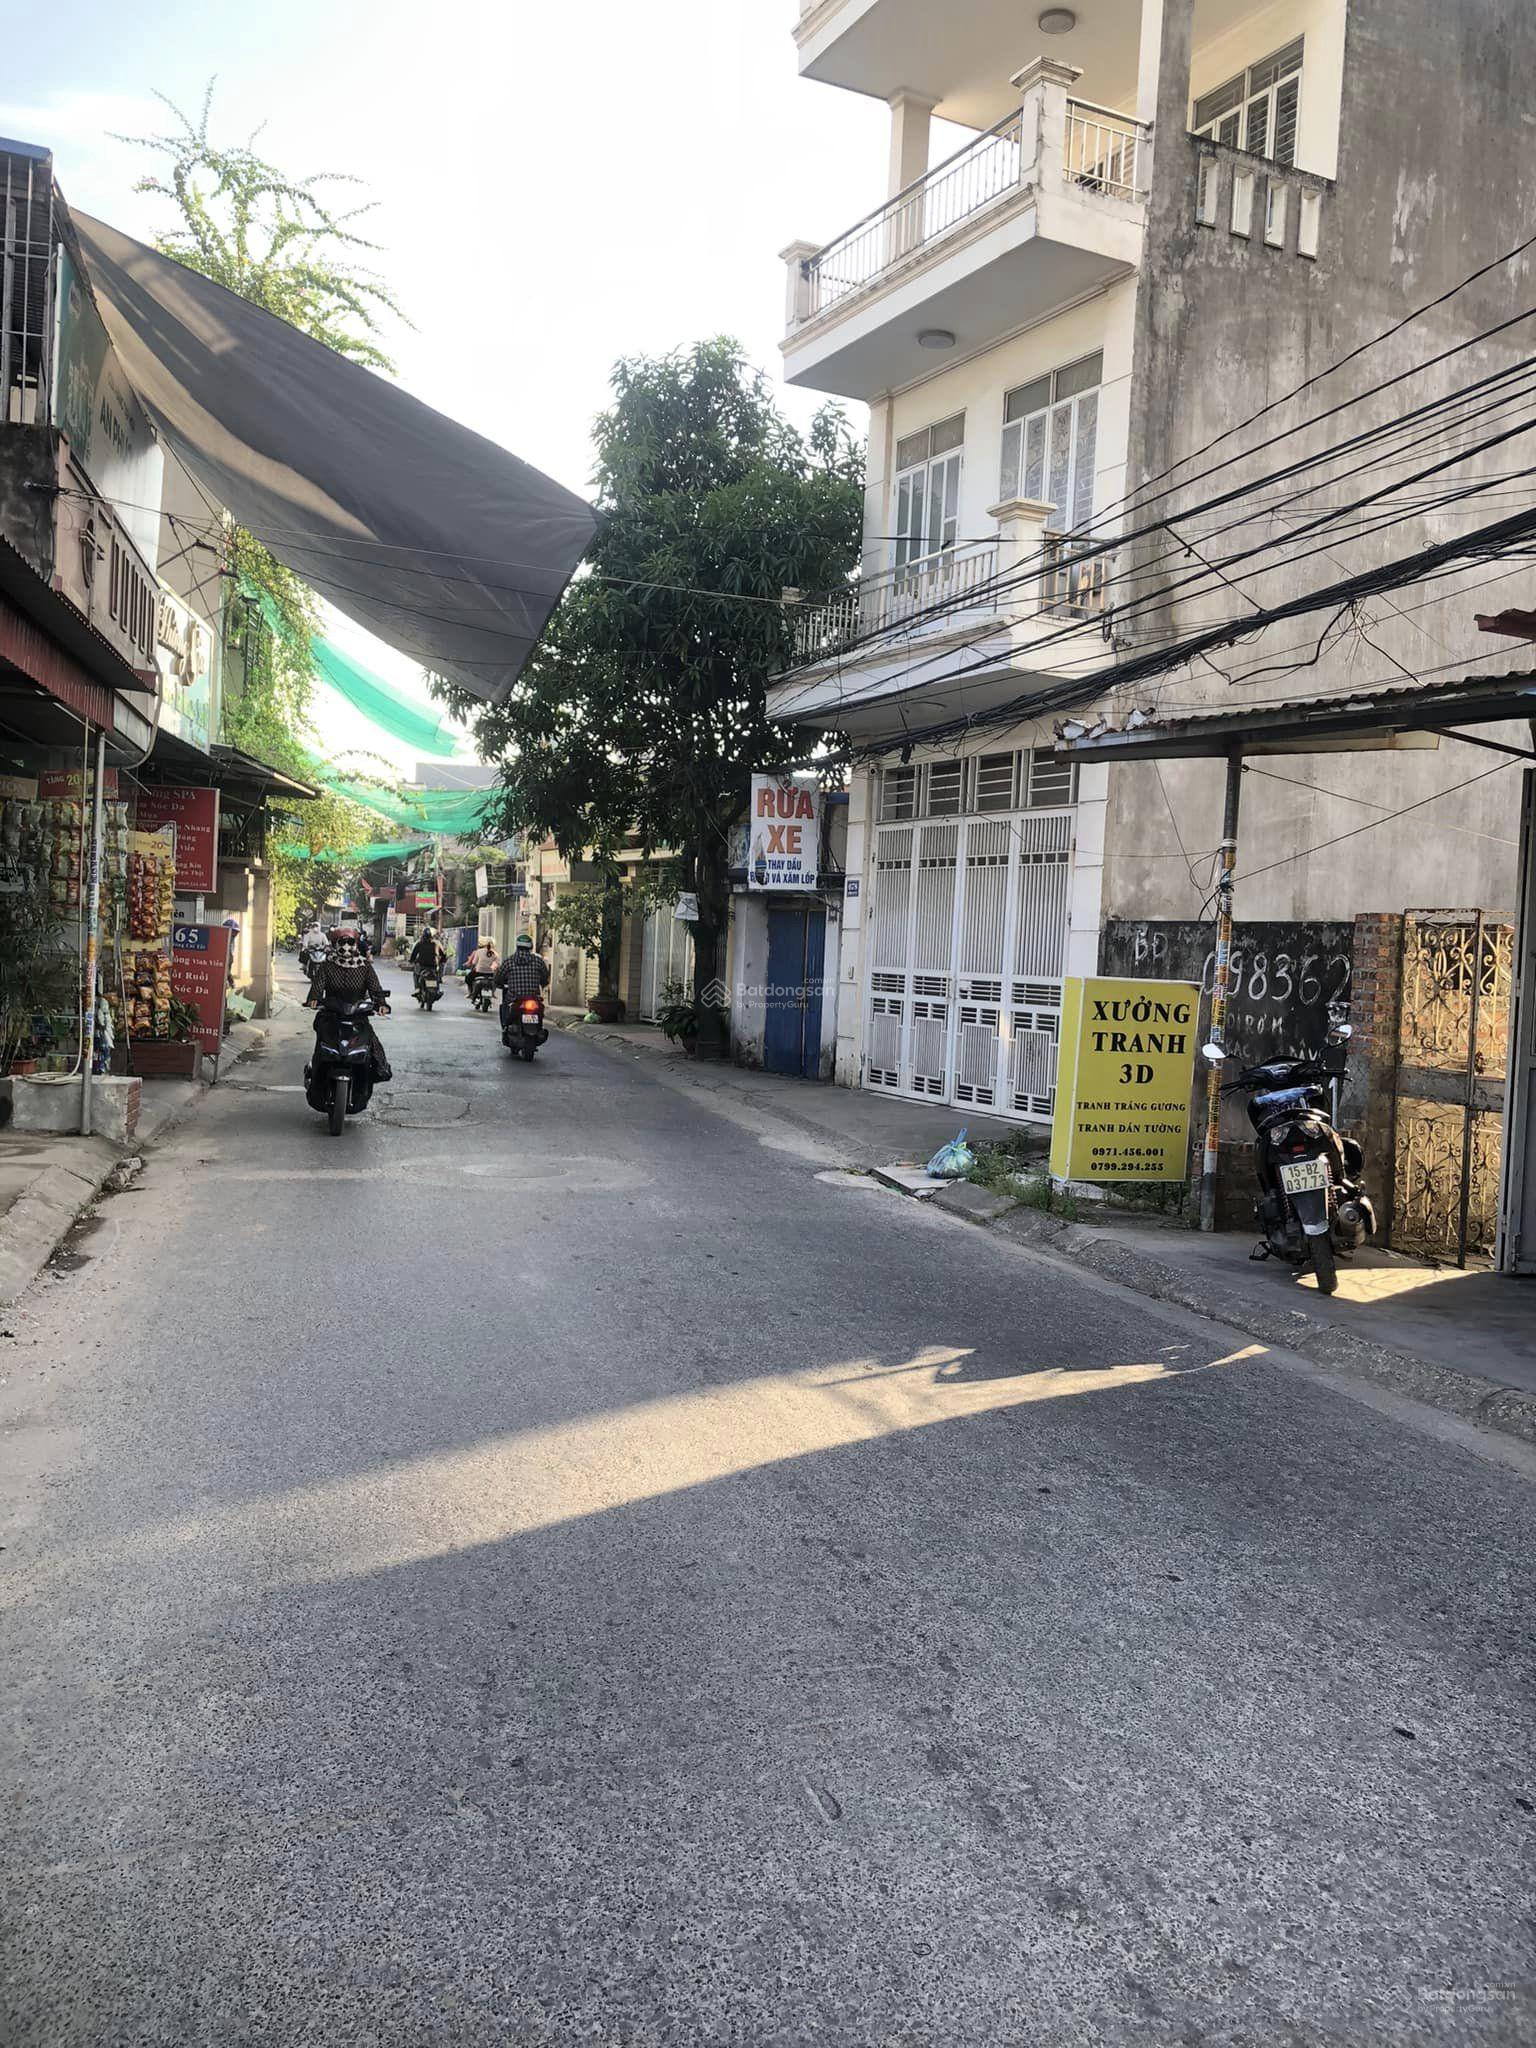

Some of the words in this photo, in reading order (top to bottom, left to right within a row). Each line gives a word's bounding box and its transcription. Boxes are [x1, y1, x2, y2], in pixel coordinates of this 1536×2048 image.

[757, 779, 814, 819] RỬA
[767, 824, 802, 854] XE
[768, 859, 785, 870] THAY
[175, 927, 199, 944] 65
[195, 985, 209, 995] Da
[1092, 995, 1190, 1024] XƯỞNG
[1092, 1032, 1187, 1054] TRANH
[1119, 1063, 1154, 1084] 3D
[1077, 1101, 1111, 1111] TRANH
[1114, 1100, 1148, 1111] TRÁNG
[1150, 1102, 1186, 1112] GƯƠNG
[1078, 1123, 1115, 1134] TRANH
[1118, 1122, 1140, 1134] DÁN
[1144, 1122, 1182, 1134] TƯỜNG
[1092, 1147, 1164, 1157] 0971.456.001
[1090, 1161, 1164, 1172] 0799.294.255
[1289, 1162, 1320, 1178] 15-B2
[1286, 1174, 1326, 1192] 037.73
